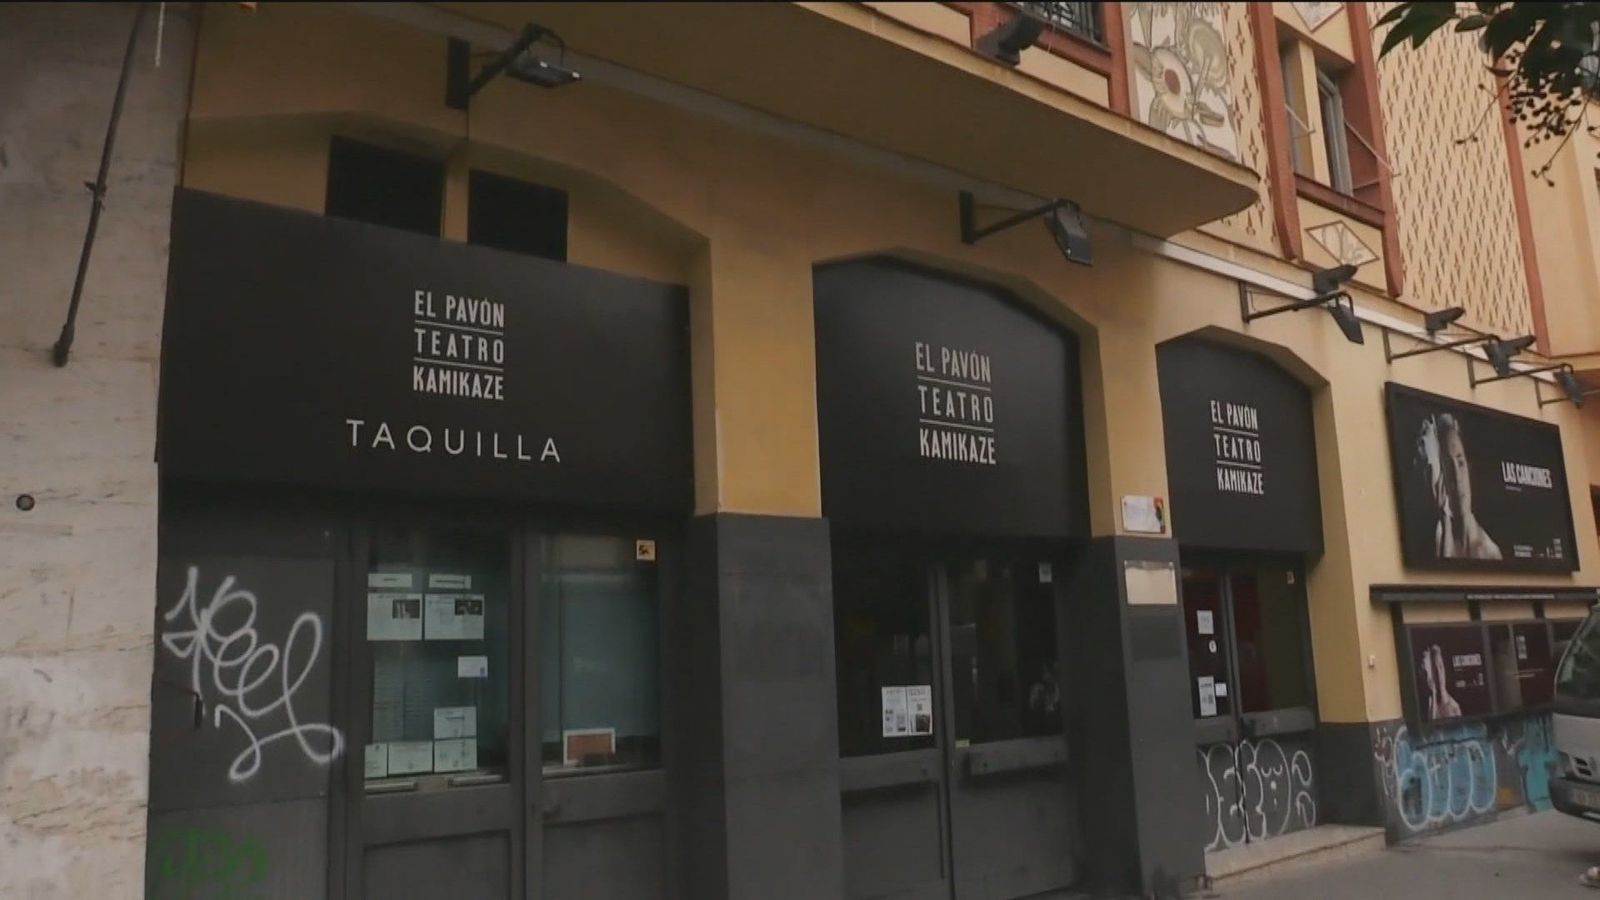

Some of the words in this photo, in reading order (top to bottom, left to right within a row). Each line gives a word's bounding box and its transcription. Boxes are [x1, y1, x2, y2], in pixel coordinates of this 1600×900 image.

[414, 290, 436, 318] EL
[445, 295, 504, 328] PAVÓN
[414, 328, 504, 364] TEATRO
[915, 341, 935, 373] EL
[941, 347, 991, 383] PAVÓN
[413, 365, 504, 400] KAMIKAZE
[918, 385, 994, 423] TEATRO
[1210, 400, 1224, 425] EL
[346, 418, 560, 463] TAQUILLA
[920, 427, 996, 465] KAMIKAZE
[1213, 433, 1261, 463] TEATRO
[1216, 467, 1264, 495] KAMIKAZE
[1501, 461, 1517, 483] LAS
